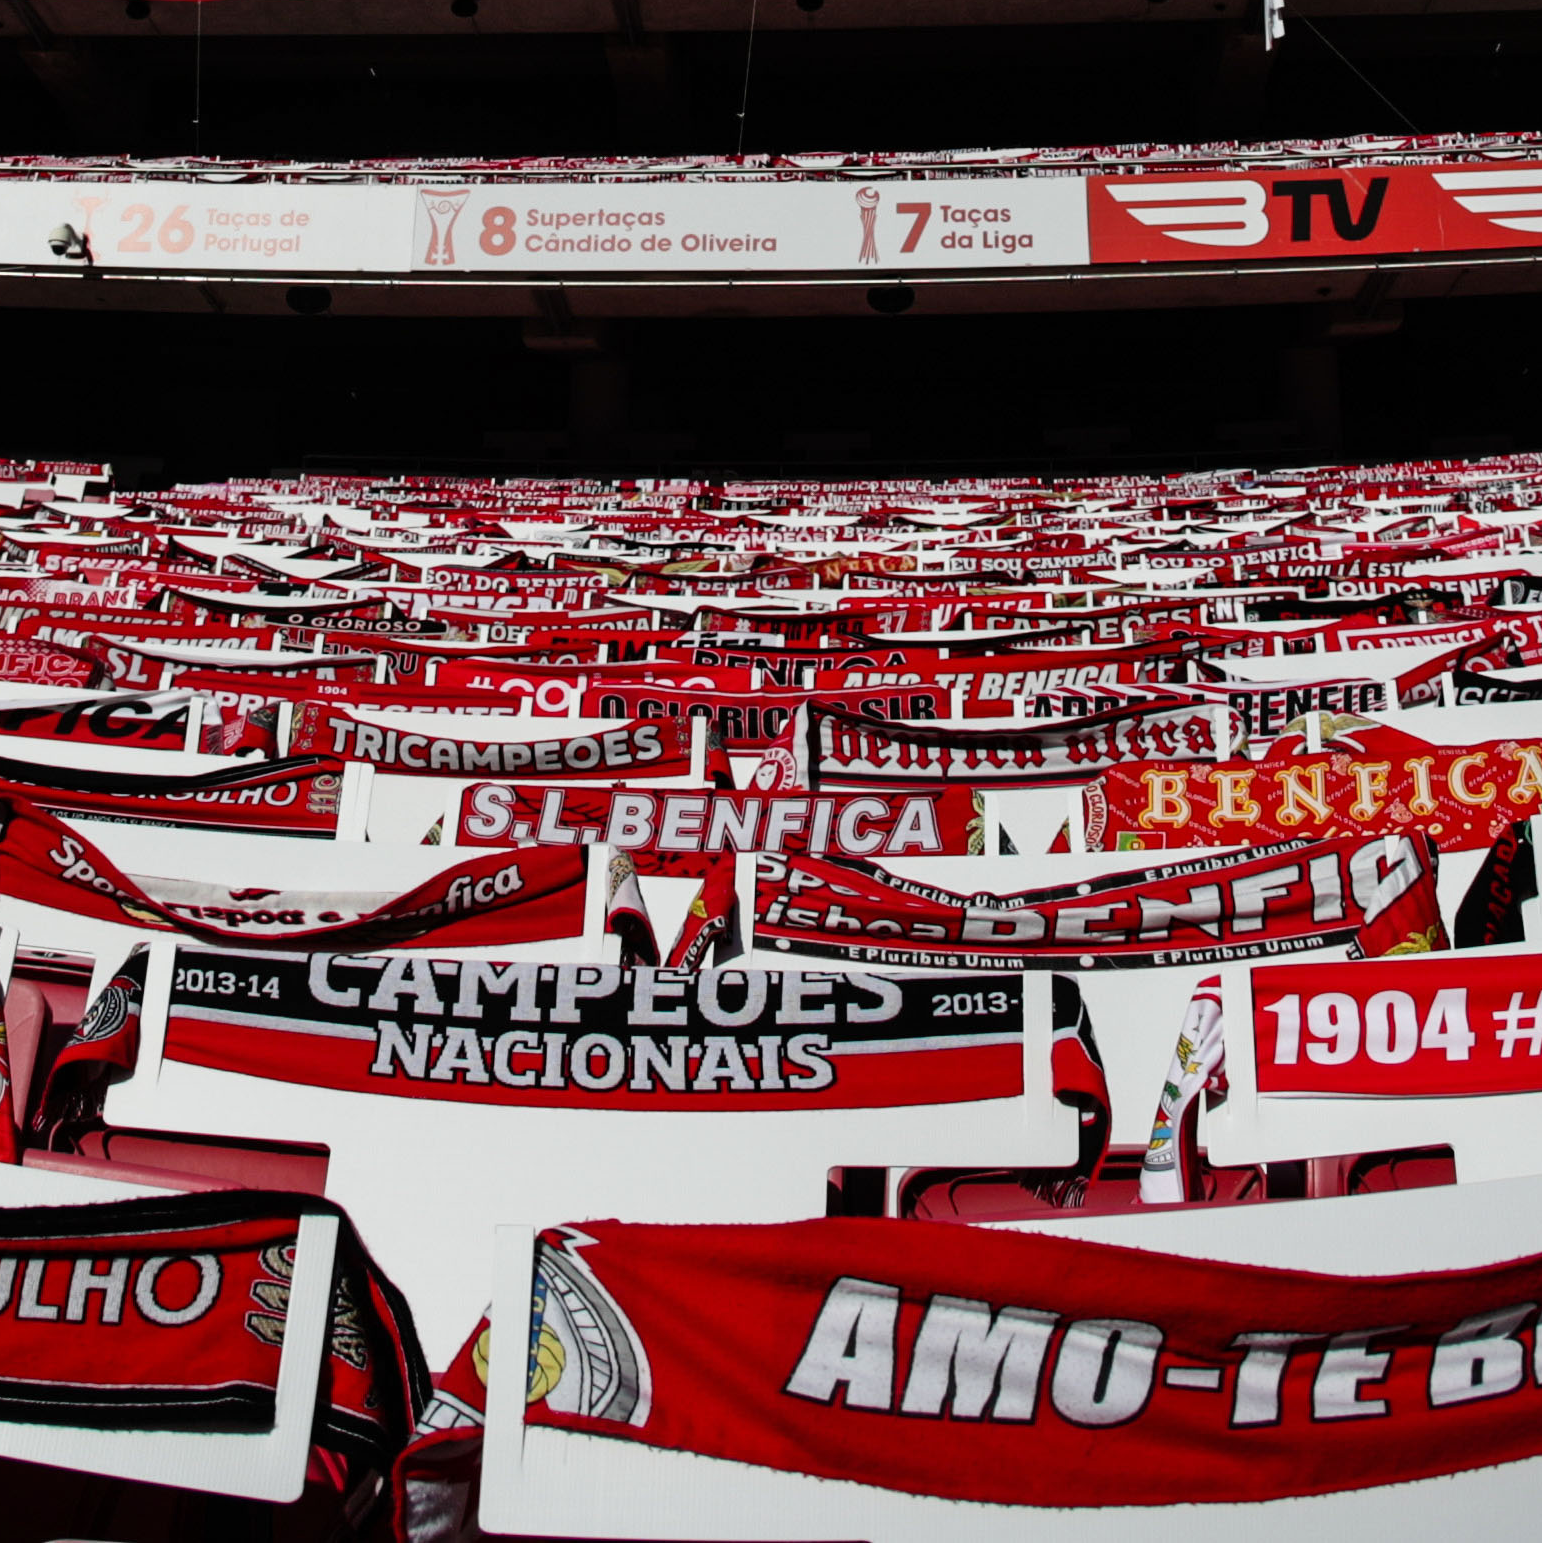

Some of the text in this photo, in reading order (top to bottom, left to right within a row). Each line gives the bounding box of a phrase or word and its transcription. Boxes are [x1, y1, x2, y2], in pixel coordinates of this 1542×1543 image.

[117, 203, 196, 255] 26
[206, 207, 310, 231] Taças de
[477, 204, 518, 257] 8
[525, 207, 666, 231] Supertaças
[895, 202, 932, 254] 7
[939, 202, 1012, 227] Taças
[203, 231, 303, 258] Portugal
[524, 231, 778, 255] Cândido de Oliveira
[939, 229, 1035, 255] da Liga
[310, 614, 422, 633] GLORIOSO
[1144, 868, 1157, 882] E
[1160, 849, 1248, 879] Pluribus
[874, 868, 888, 886] E
[888, 875, 974, 908] Pluribus
[848, 946, 1024, 970] E Pluribus Unum
[1154, 933, 1324, 965] E Pluribus Unum
[1264, 989, 1475, 1067] 1904
[369, 1023, 837, 1092] NACIONAIS
[782, 1273, 1395, 1432] AMO-TE
